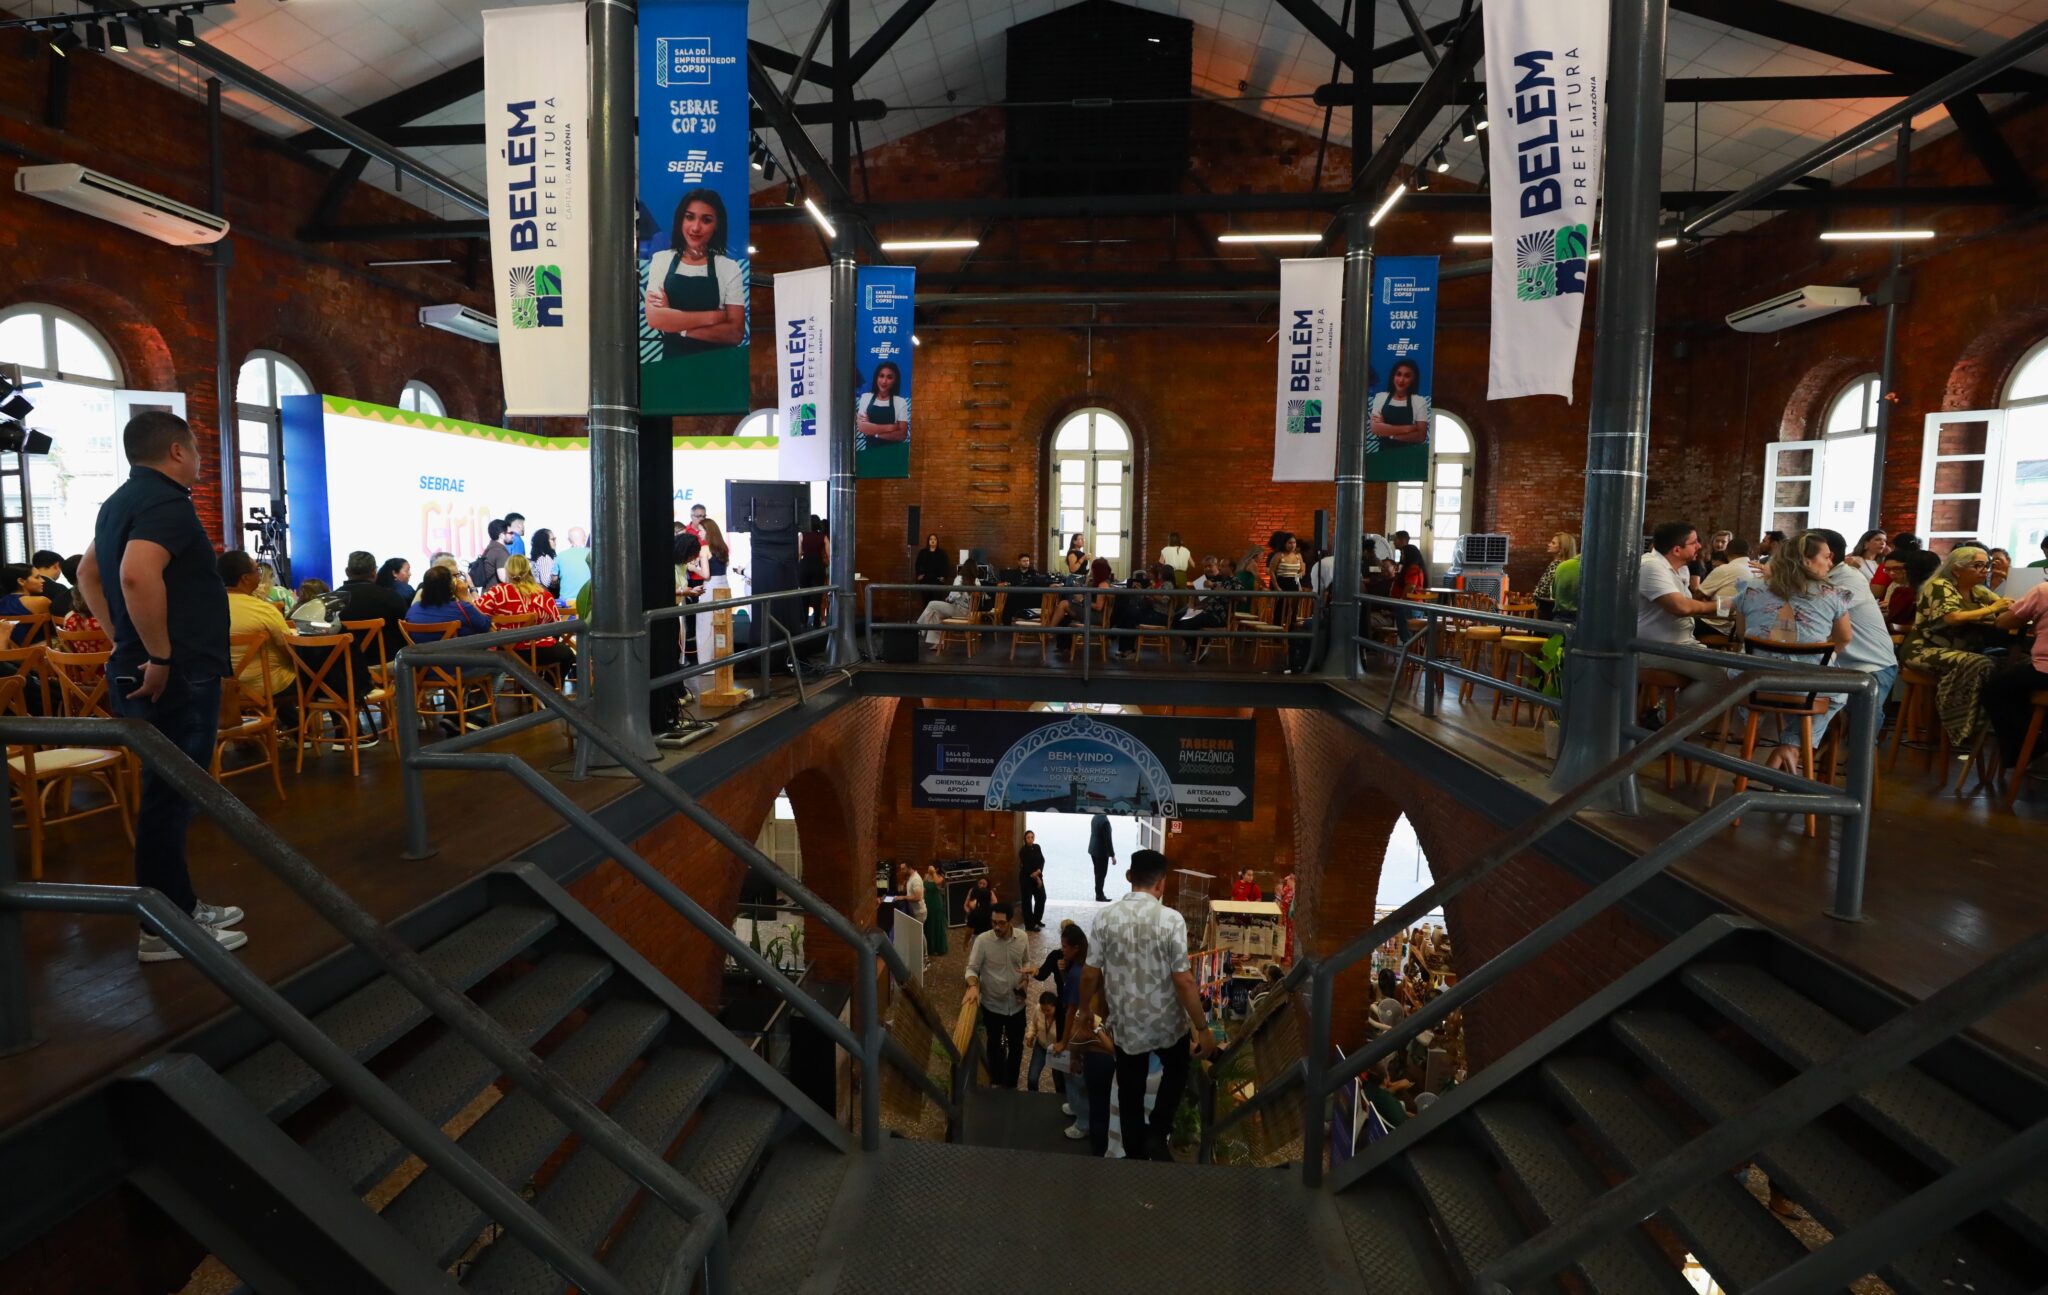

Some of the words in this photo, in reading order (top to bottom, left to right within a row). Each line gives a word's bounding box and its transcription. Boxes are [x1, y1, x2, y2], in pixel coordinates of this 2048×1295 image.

[674, 48, 694, 56] SALA
[695, 48, 706, 56] DO
[674, 65, 706, 73] COP30
[670, 99, 720, 116] SEBRAE
[1590, 76, 1598, 127] AMAZÔNIA
[672, 117, 698, 134] COP
[700, 118, 717, 134] 30
[1565, 47, 1587, 205] PREFEITURA
[1507, 50, 1562, 218] BELÉM
[545, 97, 557, 248] PREFEITURA
[667, 161, 724, 173] SEBRAE
[501, 100, 538, 251] BELÉM
[872, 316, 899, 325] SEBRAE
[1390, 310, 1418, 320] SEBRAE
[873, 325, 887, 334] COP
[888, 325, 897, 334] 30
[1390, 321, 1405, 330] COP
[1407, 321, 1416, 329] 30
[1289, 310, 1313, 392] BELÉM
[1314, 309, 1325, 391] PREFEITURA
[786, 319, 806, 398] BELÉM
[419, 475, 465, 493] SEBRAE
[922, 724, 957, 732] SEBRAE
[1179, 738, 1234, 750] TABERNA
[1048, 751, 1113, 763] BEM-VINDO
[1179, 750, 1235, 763] AMAZÔNICA
[1073, 767, 1117, 775] CHARMOSA
[935, 779, 975, 787] ORIENTAÇÃO
